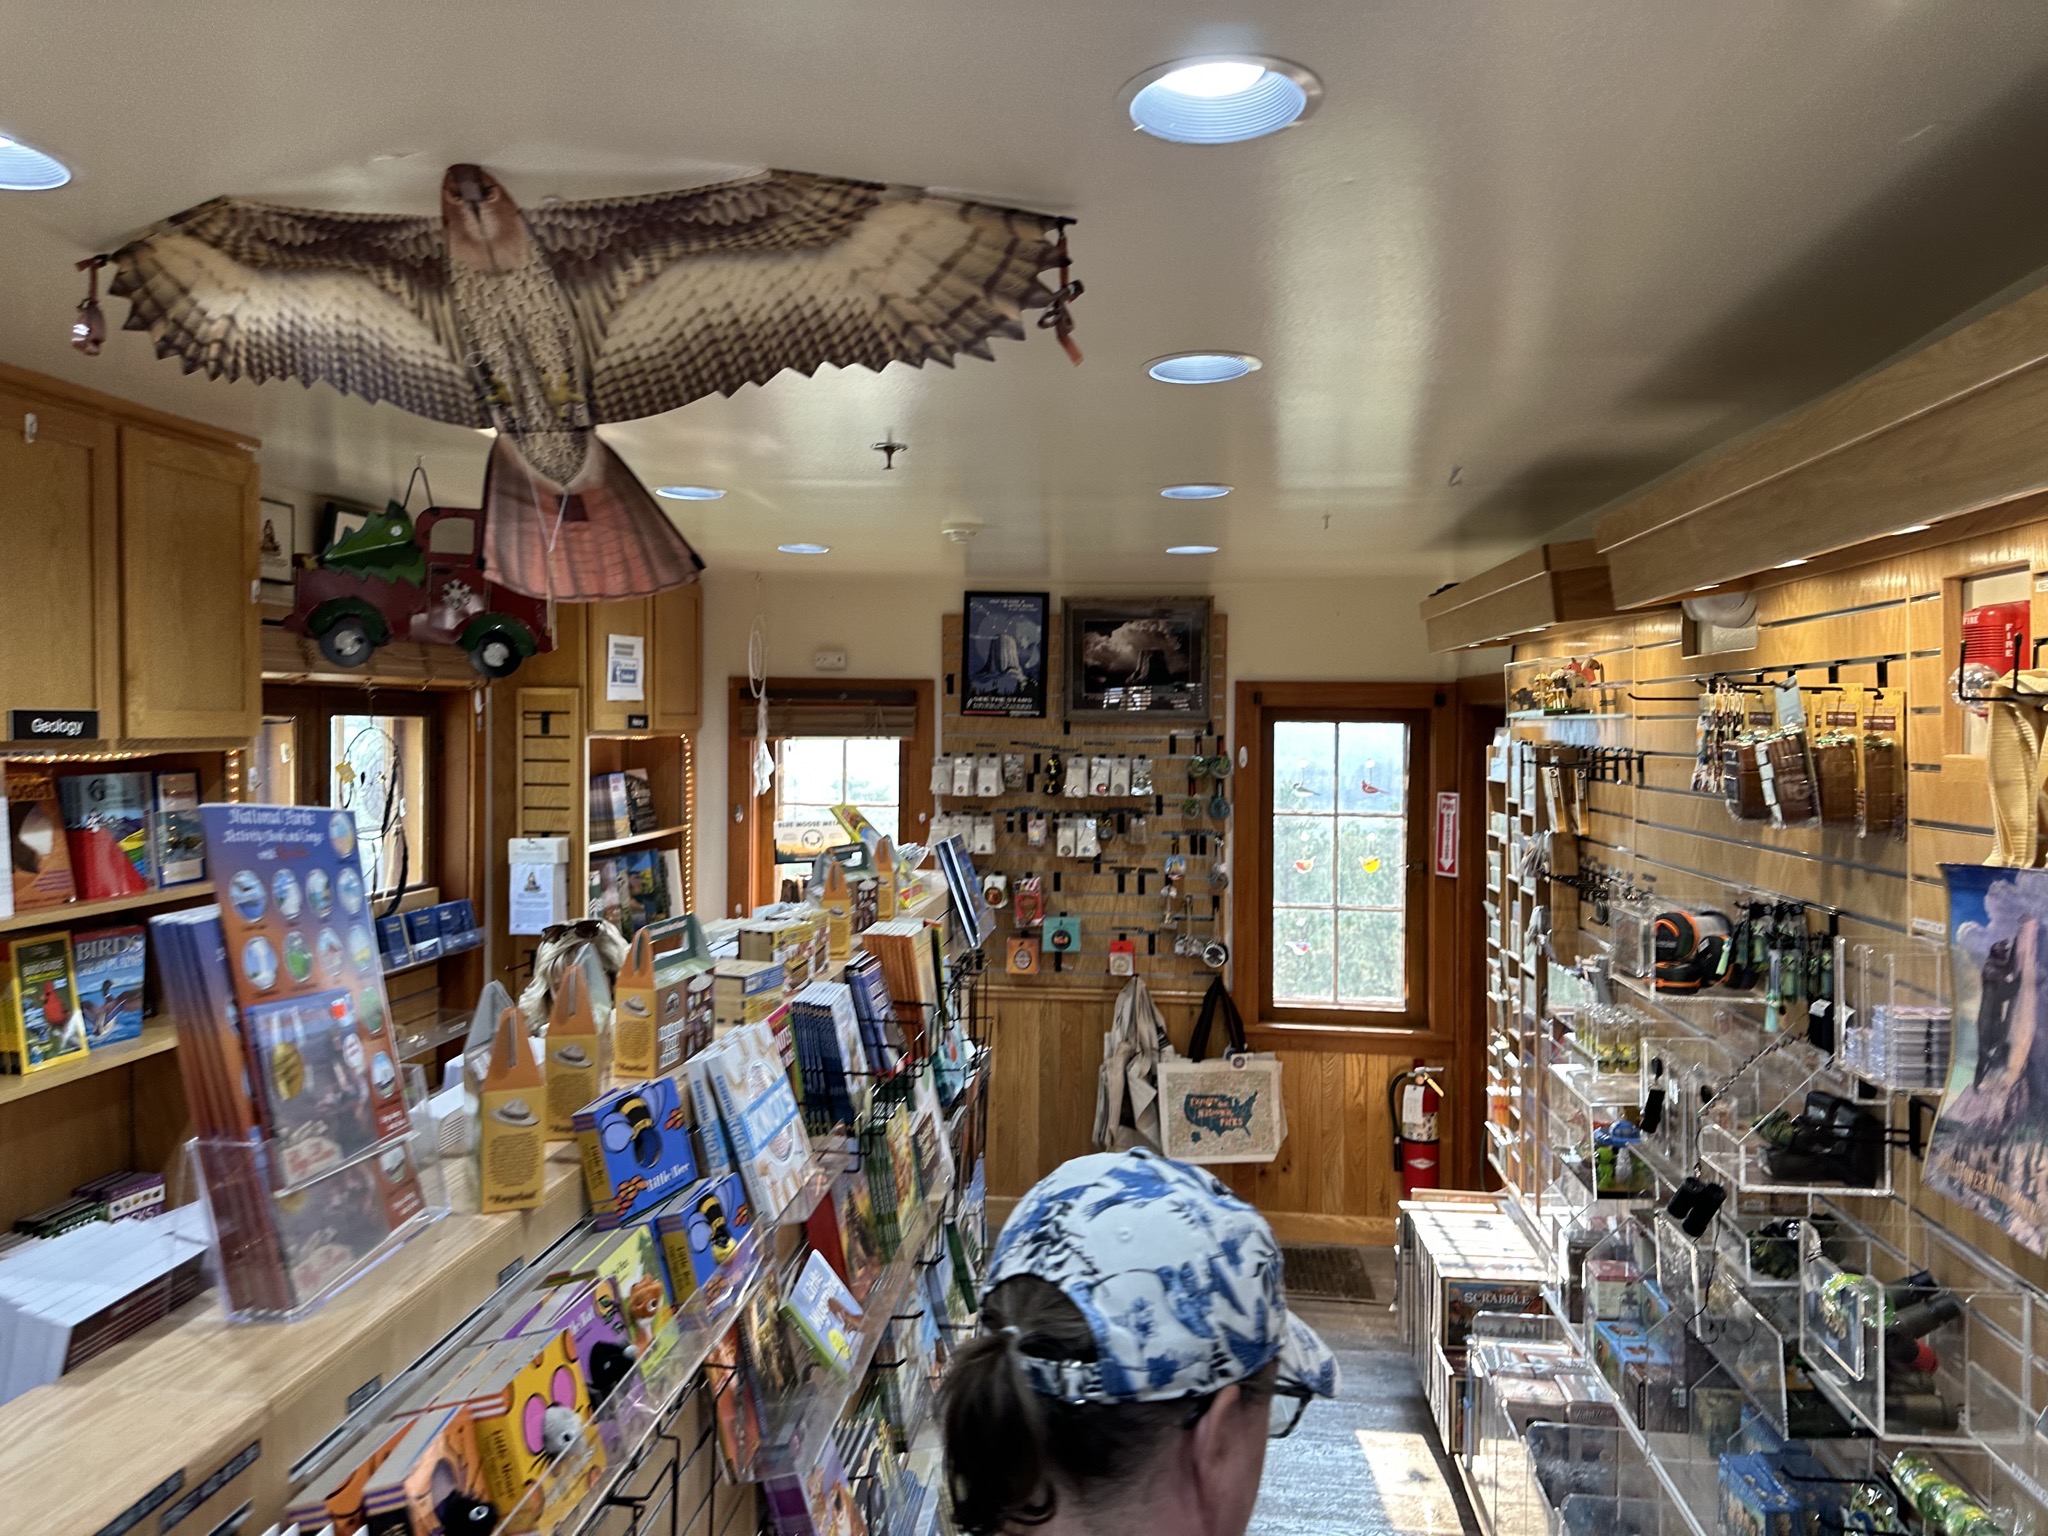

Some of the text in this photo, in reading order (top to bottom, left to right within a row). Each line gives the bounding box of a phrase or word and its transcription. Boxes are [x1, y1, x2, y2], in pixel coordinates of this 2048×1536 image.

[1963, 615, 1979, 625] FIRE
[2005, 623, 2014, 657] FIRE
[31, 718, 84, 736] Geology
[76, 935, 144, 961] BIRDS
[700, 1120, 724, 1168] KNOTS
[726, 1116, 751, 1161] KNOTS
[1463, 1291, 1530, 1306] SCRABBLE
